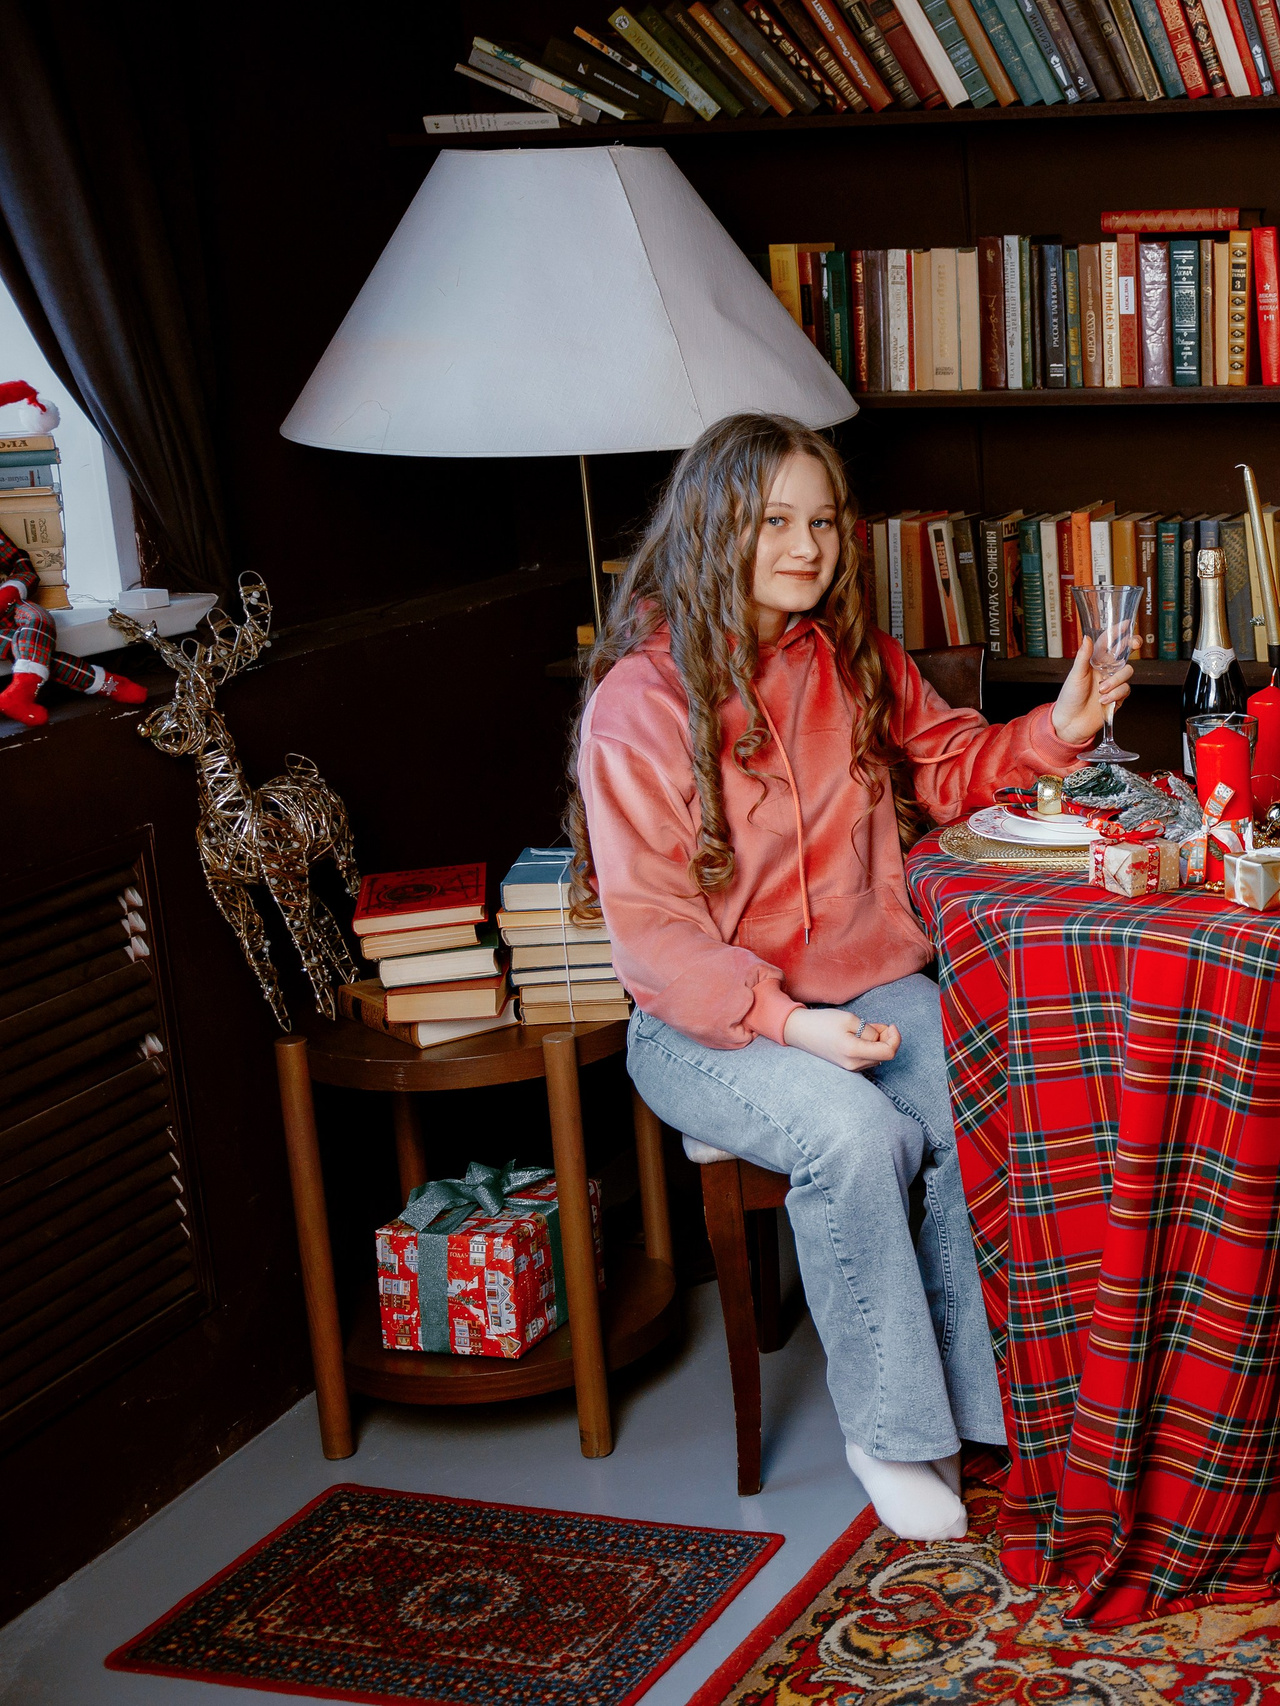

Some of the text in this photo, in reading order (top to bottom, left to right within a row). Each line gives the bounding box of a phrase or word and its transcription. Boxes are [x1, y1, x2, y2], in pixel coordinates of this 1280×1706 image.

[1027, 12, 1055, 55] БЕЛЛИНИ
[1235, 0, 1258, 41] ПИСЕМСКИ
[1009, 261, 1018, 332] ДРЕВНЕЙ ГРЕЦИИ
[1104, 249, 1114, 330] КЭТРИН КУКСОН
[1233, 279, 1242, 291] 3
[898, 345, 906, 371] ДЮМА
[1106, 333, 1115, 382] Знак судьбы
[985, 530, 1000, 635] ПЛУТАРХ СОЧИНЕНИЯ
